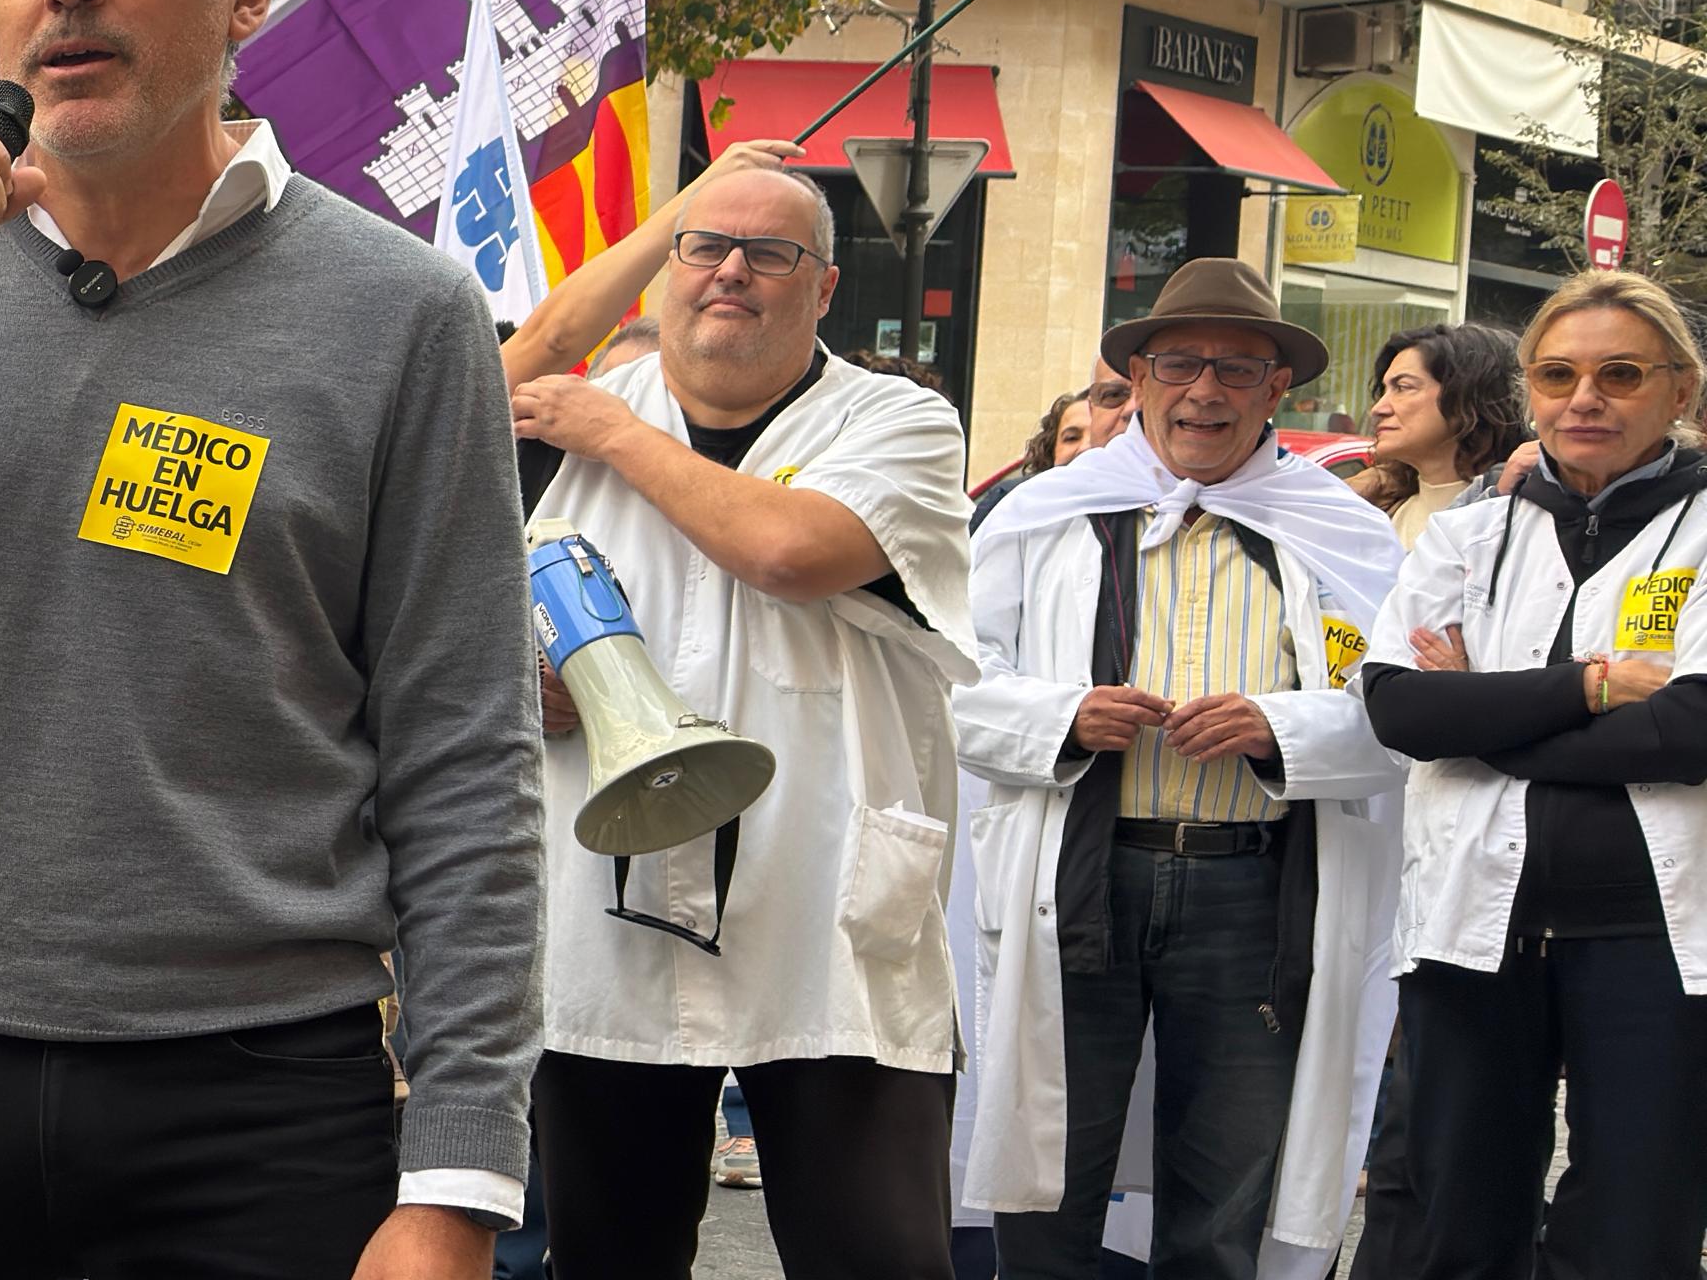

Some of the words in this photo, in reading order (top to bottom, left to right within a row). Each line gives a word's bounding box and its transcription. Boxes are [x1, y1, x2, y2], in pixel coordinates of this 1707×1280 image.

[1153, 25, 1245, 86] BARNES
[222, 408, 267, 430] BOSS
[122, 415, 252, 470] MÉDICO
[153, 456, 203, 492] EN
[99, 477, 232, 536] HUELGA
[539, 604, 557, 639] VONYX
[1652, 595, 1679, 613] EN
[1626, 614, 1678, 632] HUEL
